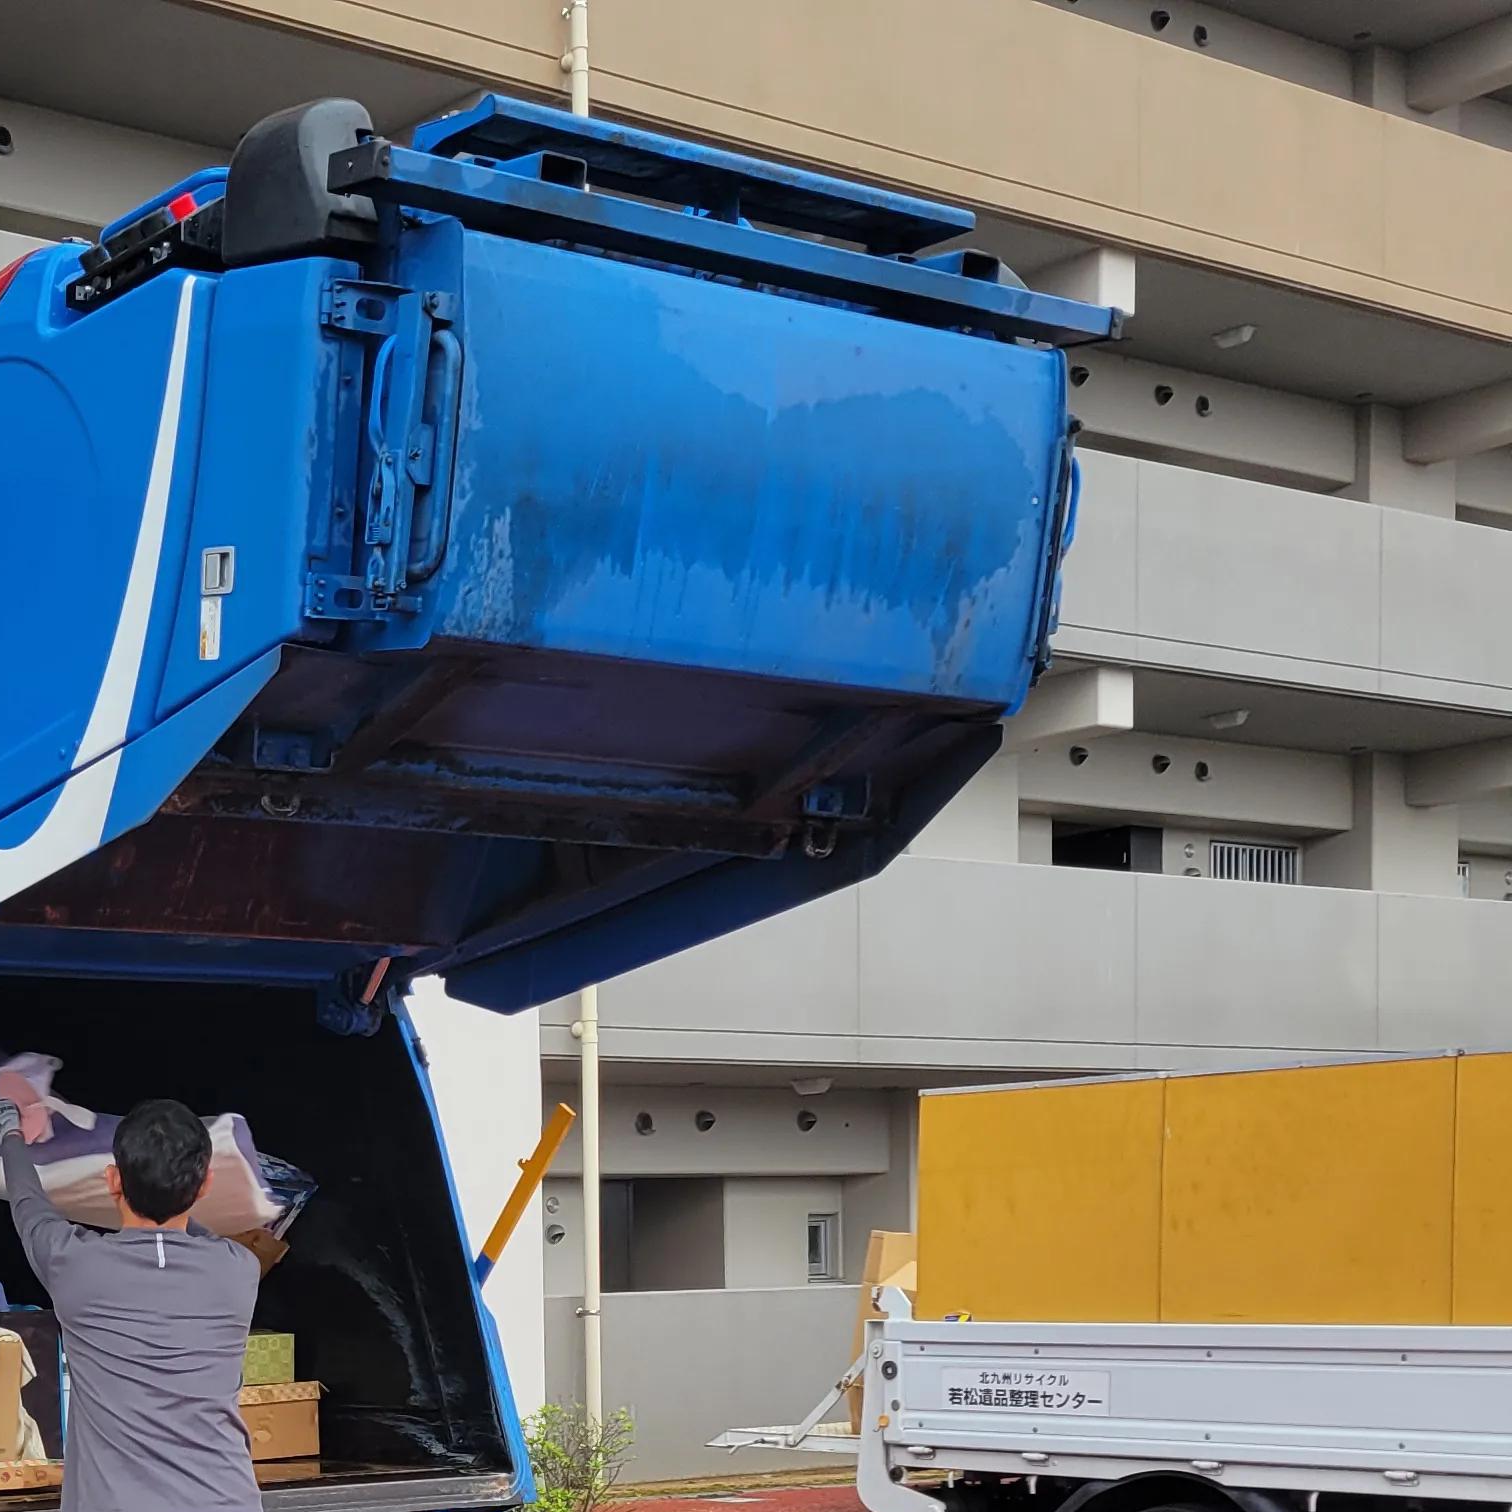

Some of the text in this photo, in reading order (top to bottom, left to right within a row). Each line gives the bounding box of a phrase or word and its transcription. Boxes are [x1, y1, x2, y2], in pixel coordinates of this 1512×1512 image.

[979, 1371, 1069, 1387] 北九州リサイクル
[948, 1387, 1103, 1409] 若松遺品整理センター
